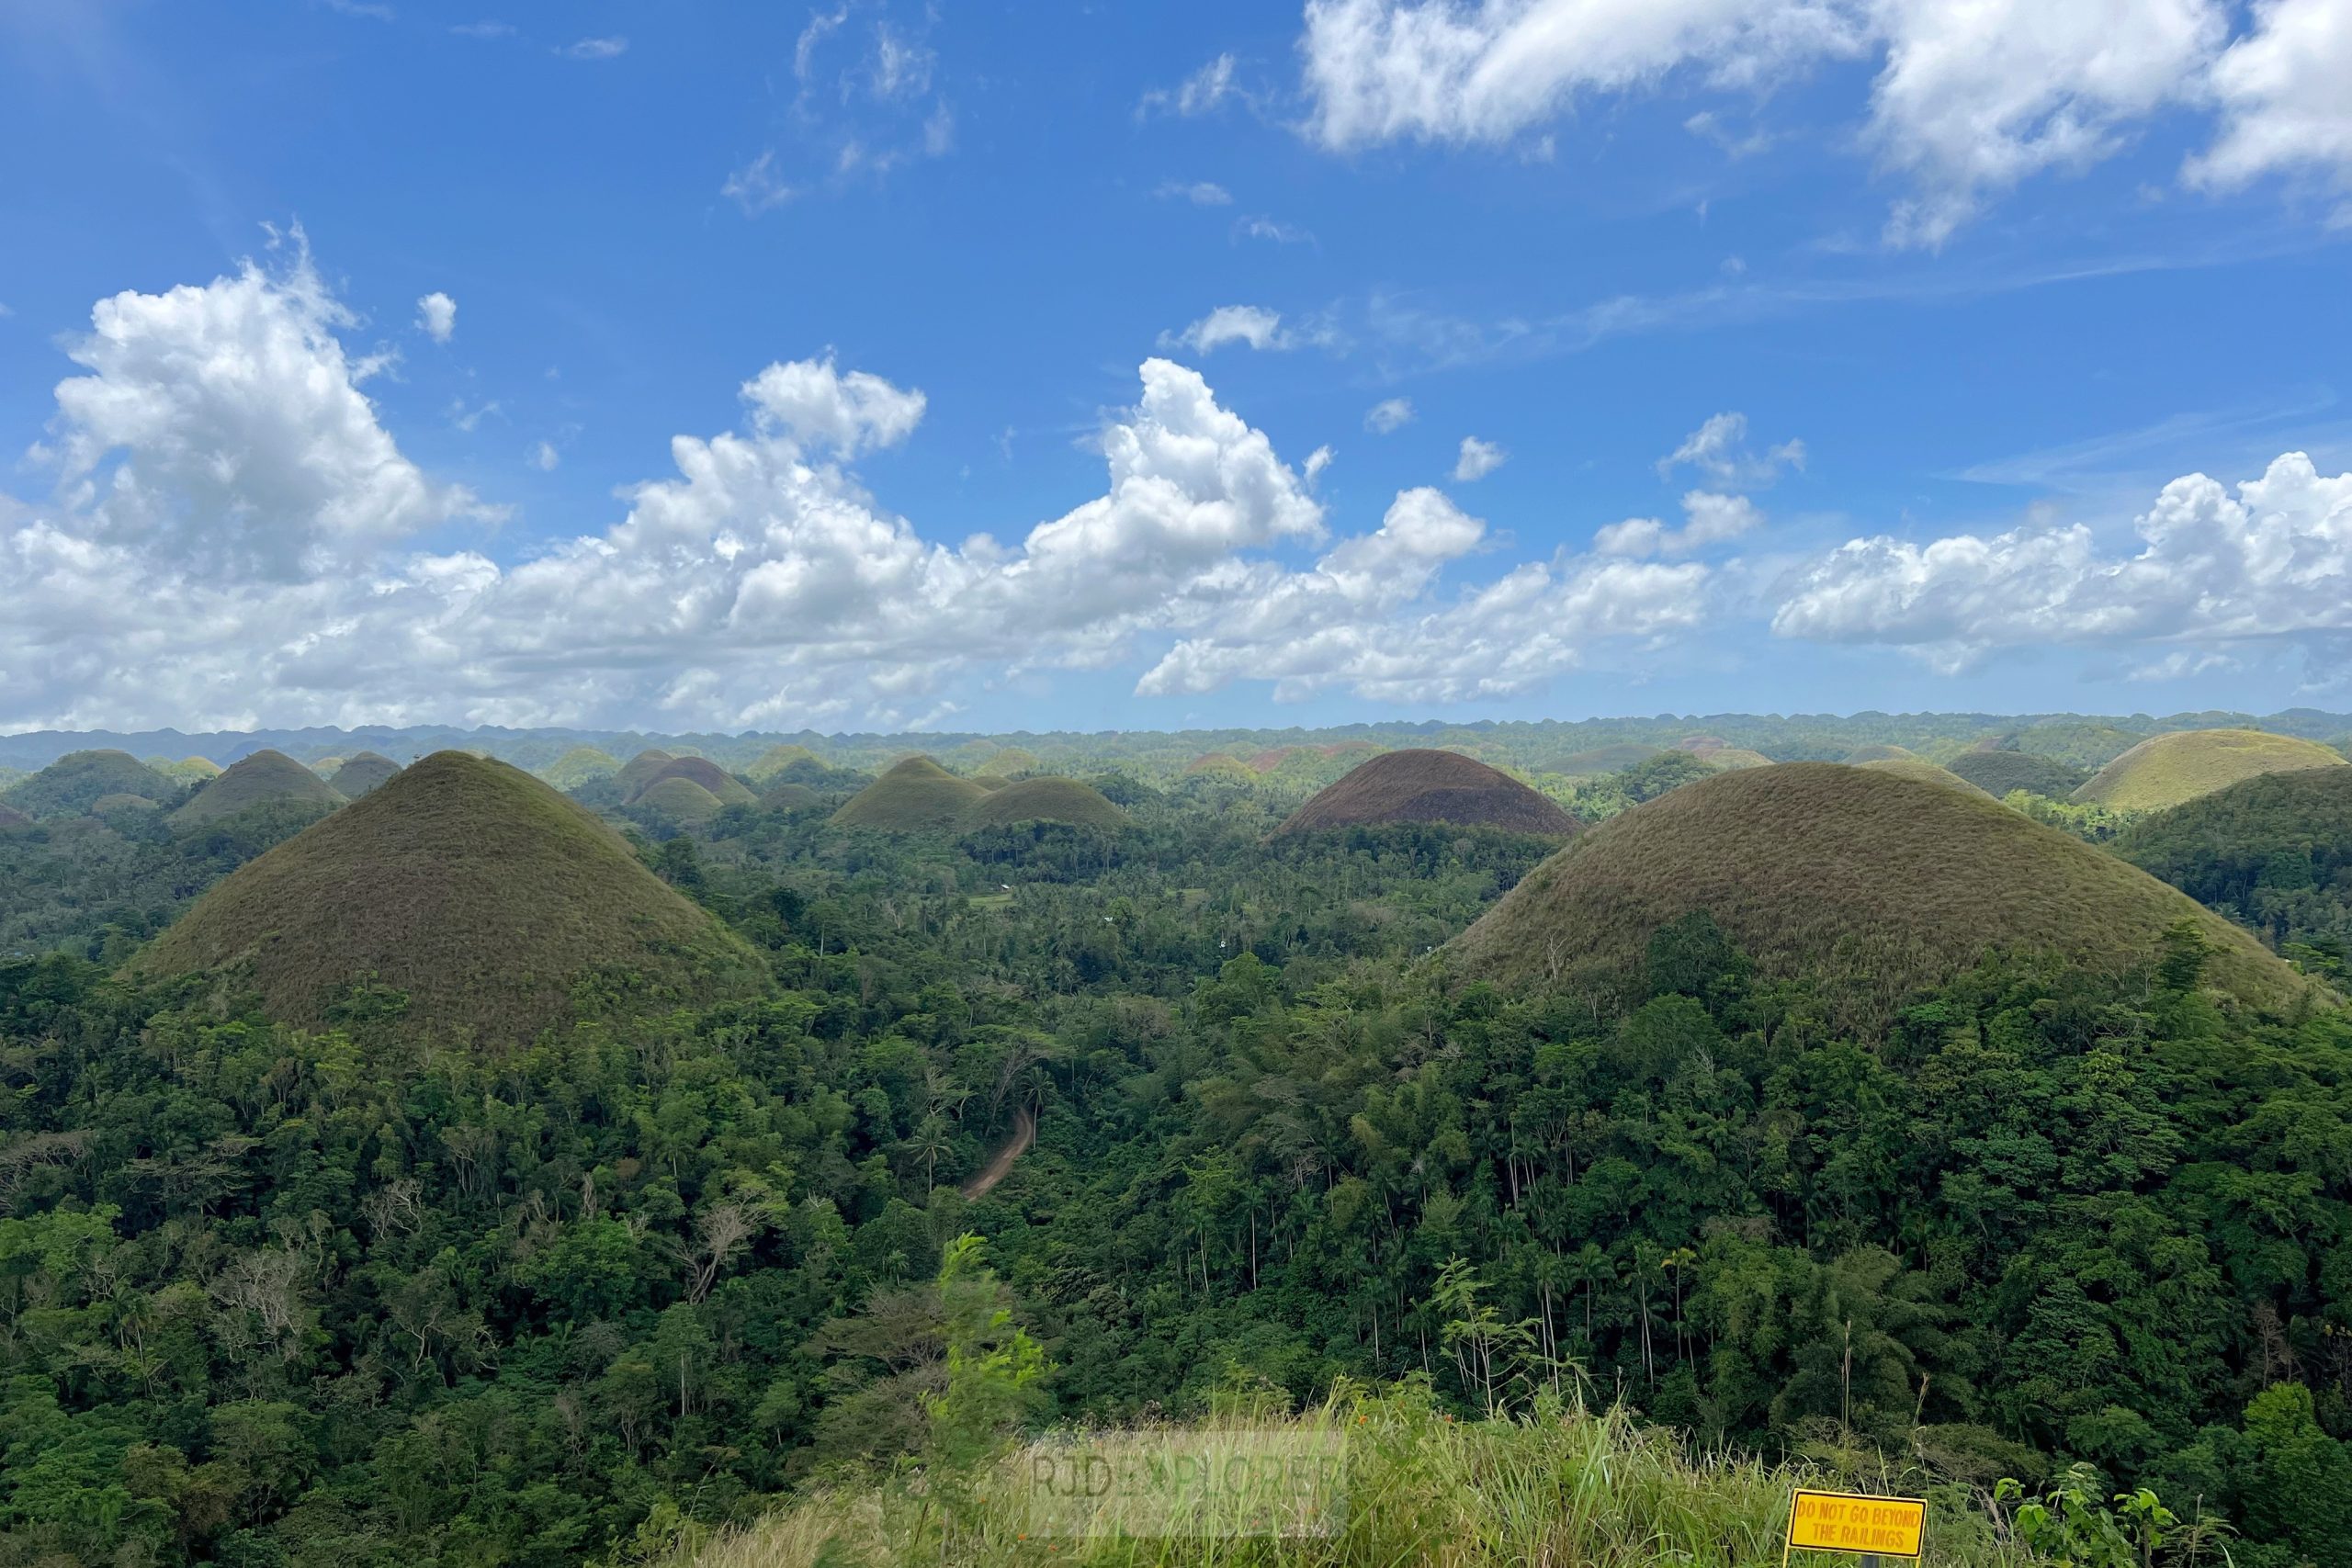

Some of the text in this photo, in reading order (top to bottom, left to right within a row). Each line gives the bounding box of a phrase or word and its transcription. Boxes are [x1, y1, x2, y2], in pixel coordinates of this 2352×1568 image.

[1796, 1500, 1920, 1529] DO NOT GO BEYOND
[1813, 1523, 1905, 1549] THE RAILINGS
